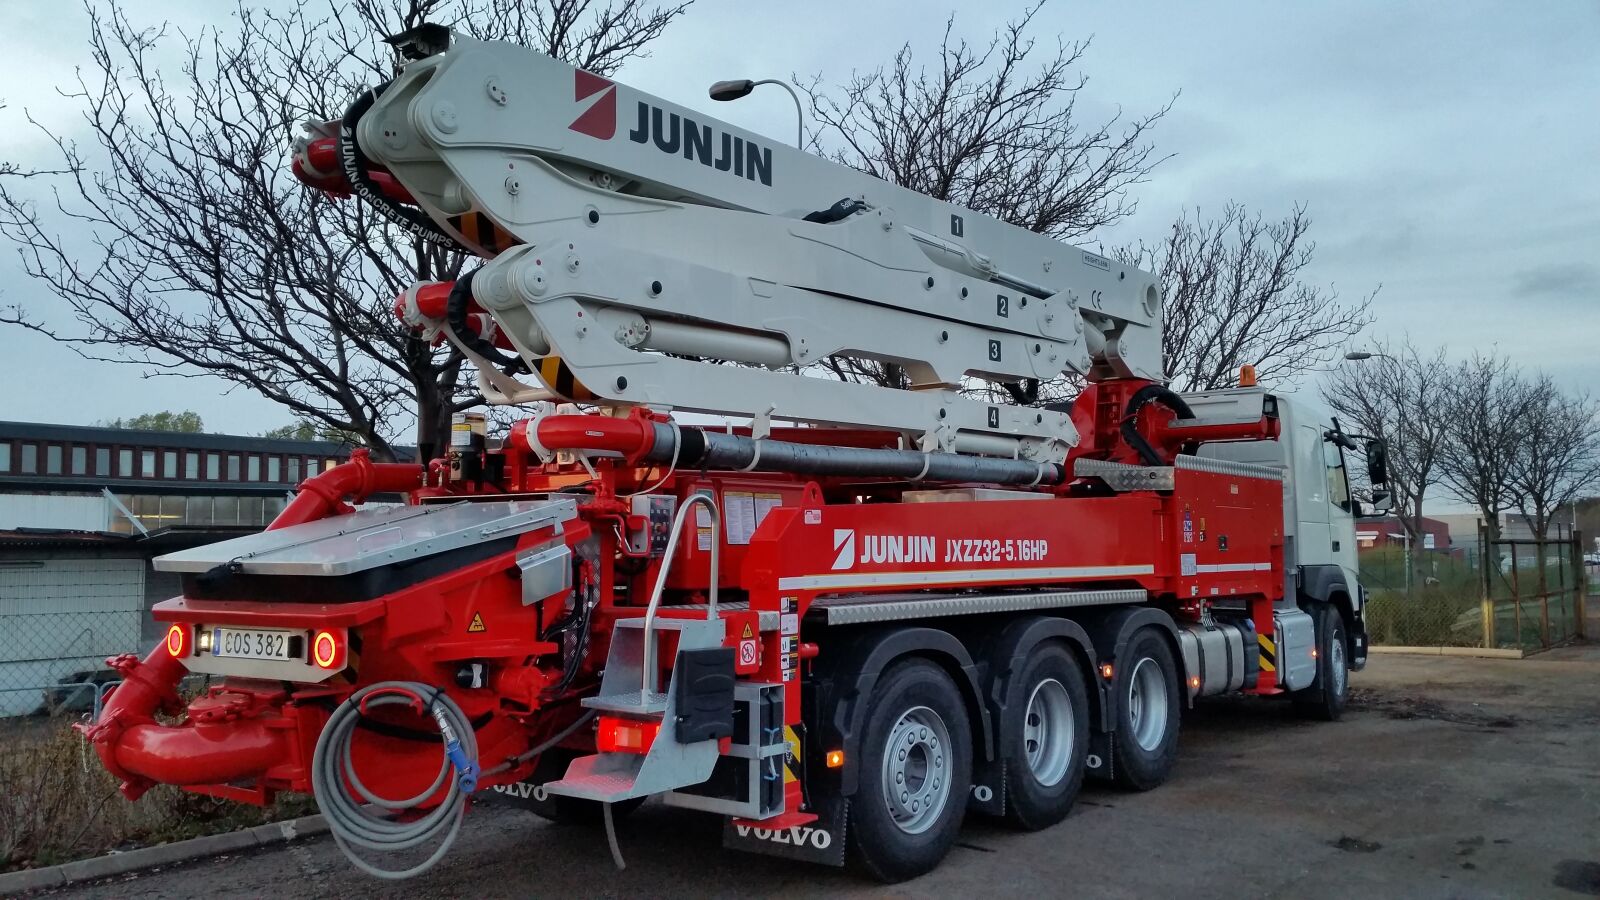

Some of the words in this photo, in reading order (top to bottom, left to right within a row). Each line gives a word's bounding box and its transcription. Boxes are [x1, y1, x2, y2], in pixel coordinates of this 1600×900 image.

[630, 101, 772, 187] JUNJIN
[354, 182, 410, 229] CONCRETE
[409, 222, 454, 247] PUMPS
[999, 299, 1006, 314] 2
[991, 342, 998, 358] 3
[990, 410, 997, 425] 4
[860, 535, 936, 564] JUNJIN
[944, 539, 1048, 562] JXZZ32-5.16HP
[225, 632, 251, 654] COS
[255, 633, 284, 657] 382
